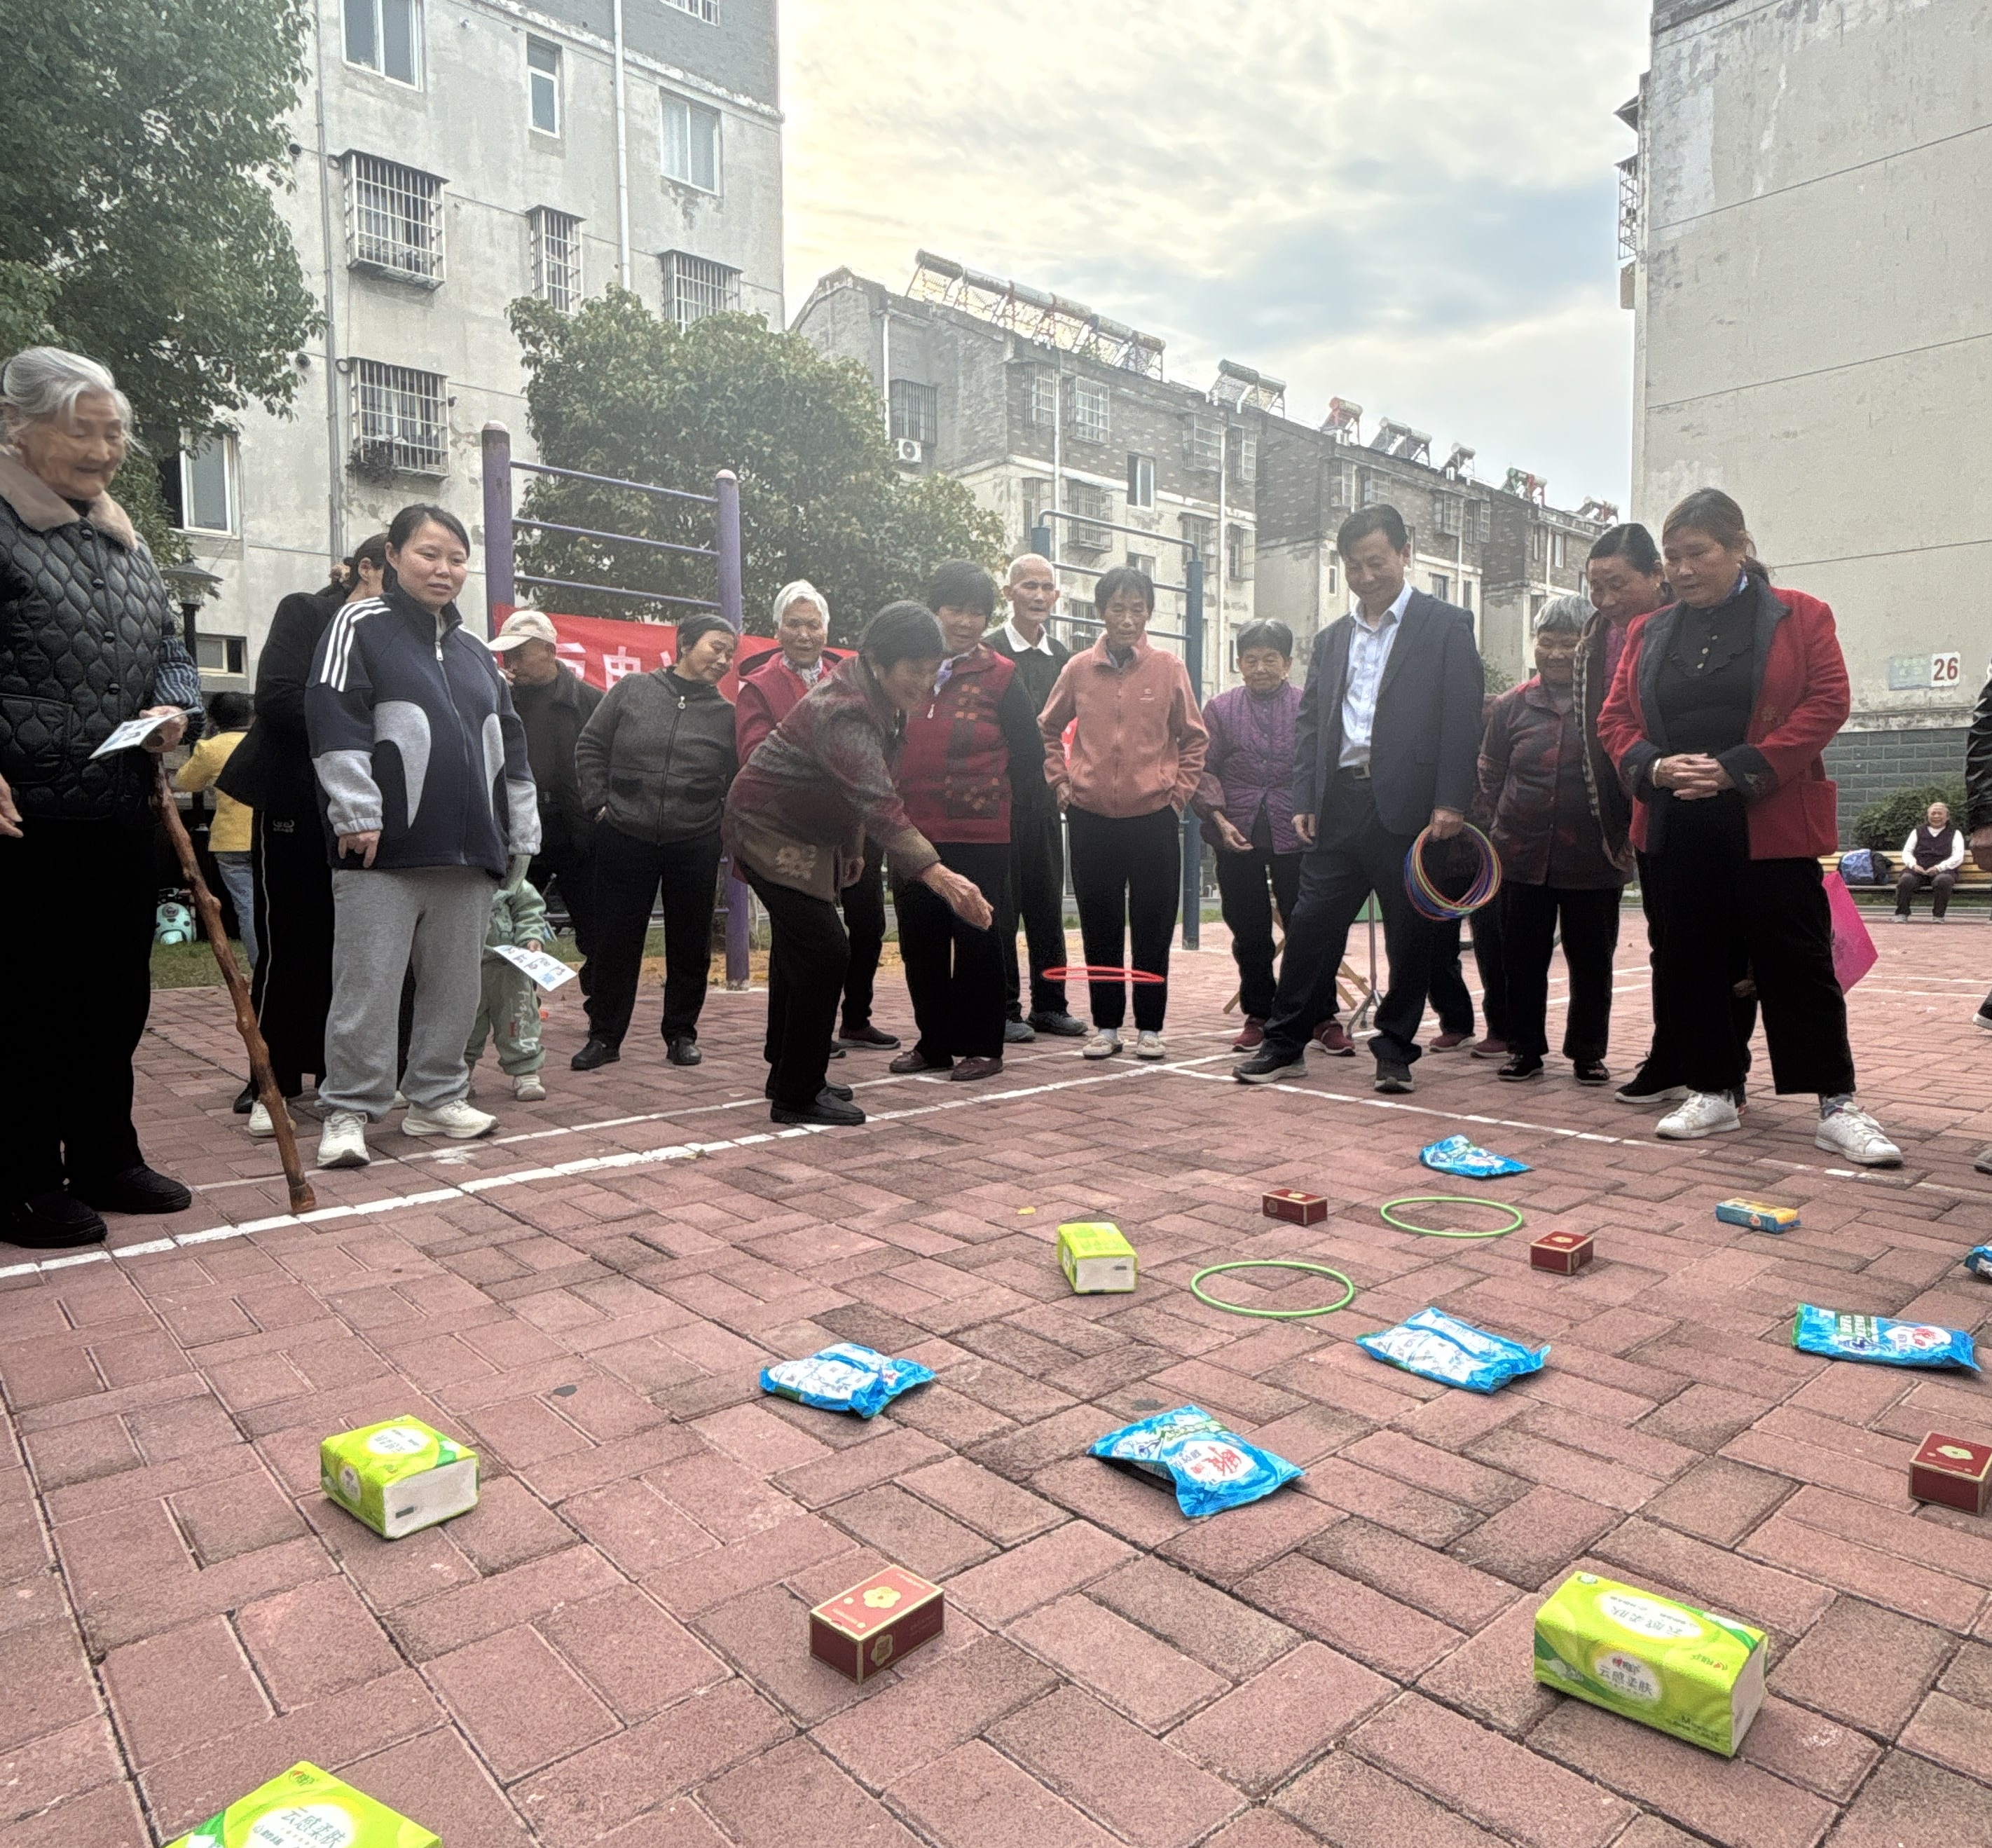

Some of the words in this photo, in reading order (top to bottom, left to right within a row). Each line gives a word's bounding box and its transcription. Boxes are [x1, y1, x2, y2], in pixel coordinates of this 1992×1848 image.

[1933, 657, 1958, 681] 26
[1599, 1664, 1654, 1697] 云感柔肤
[280, 1805, 347, 1848] 云感柔肤
